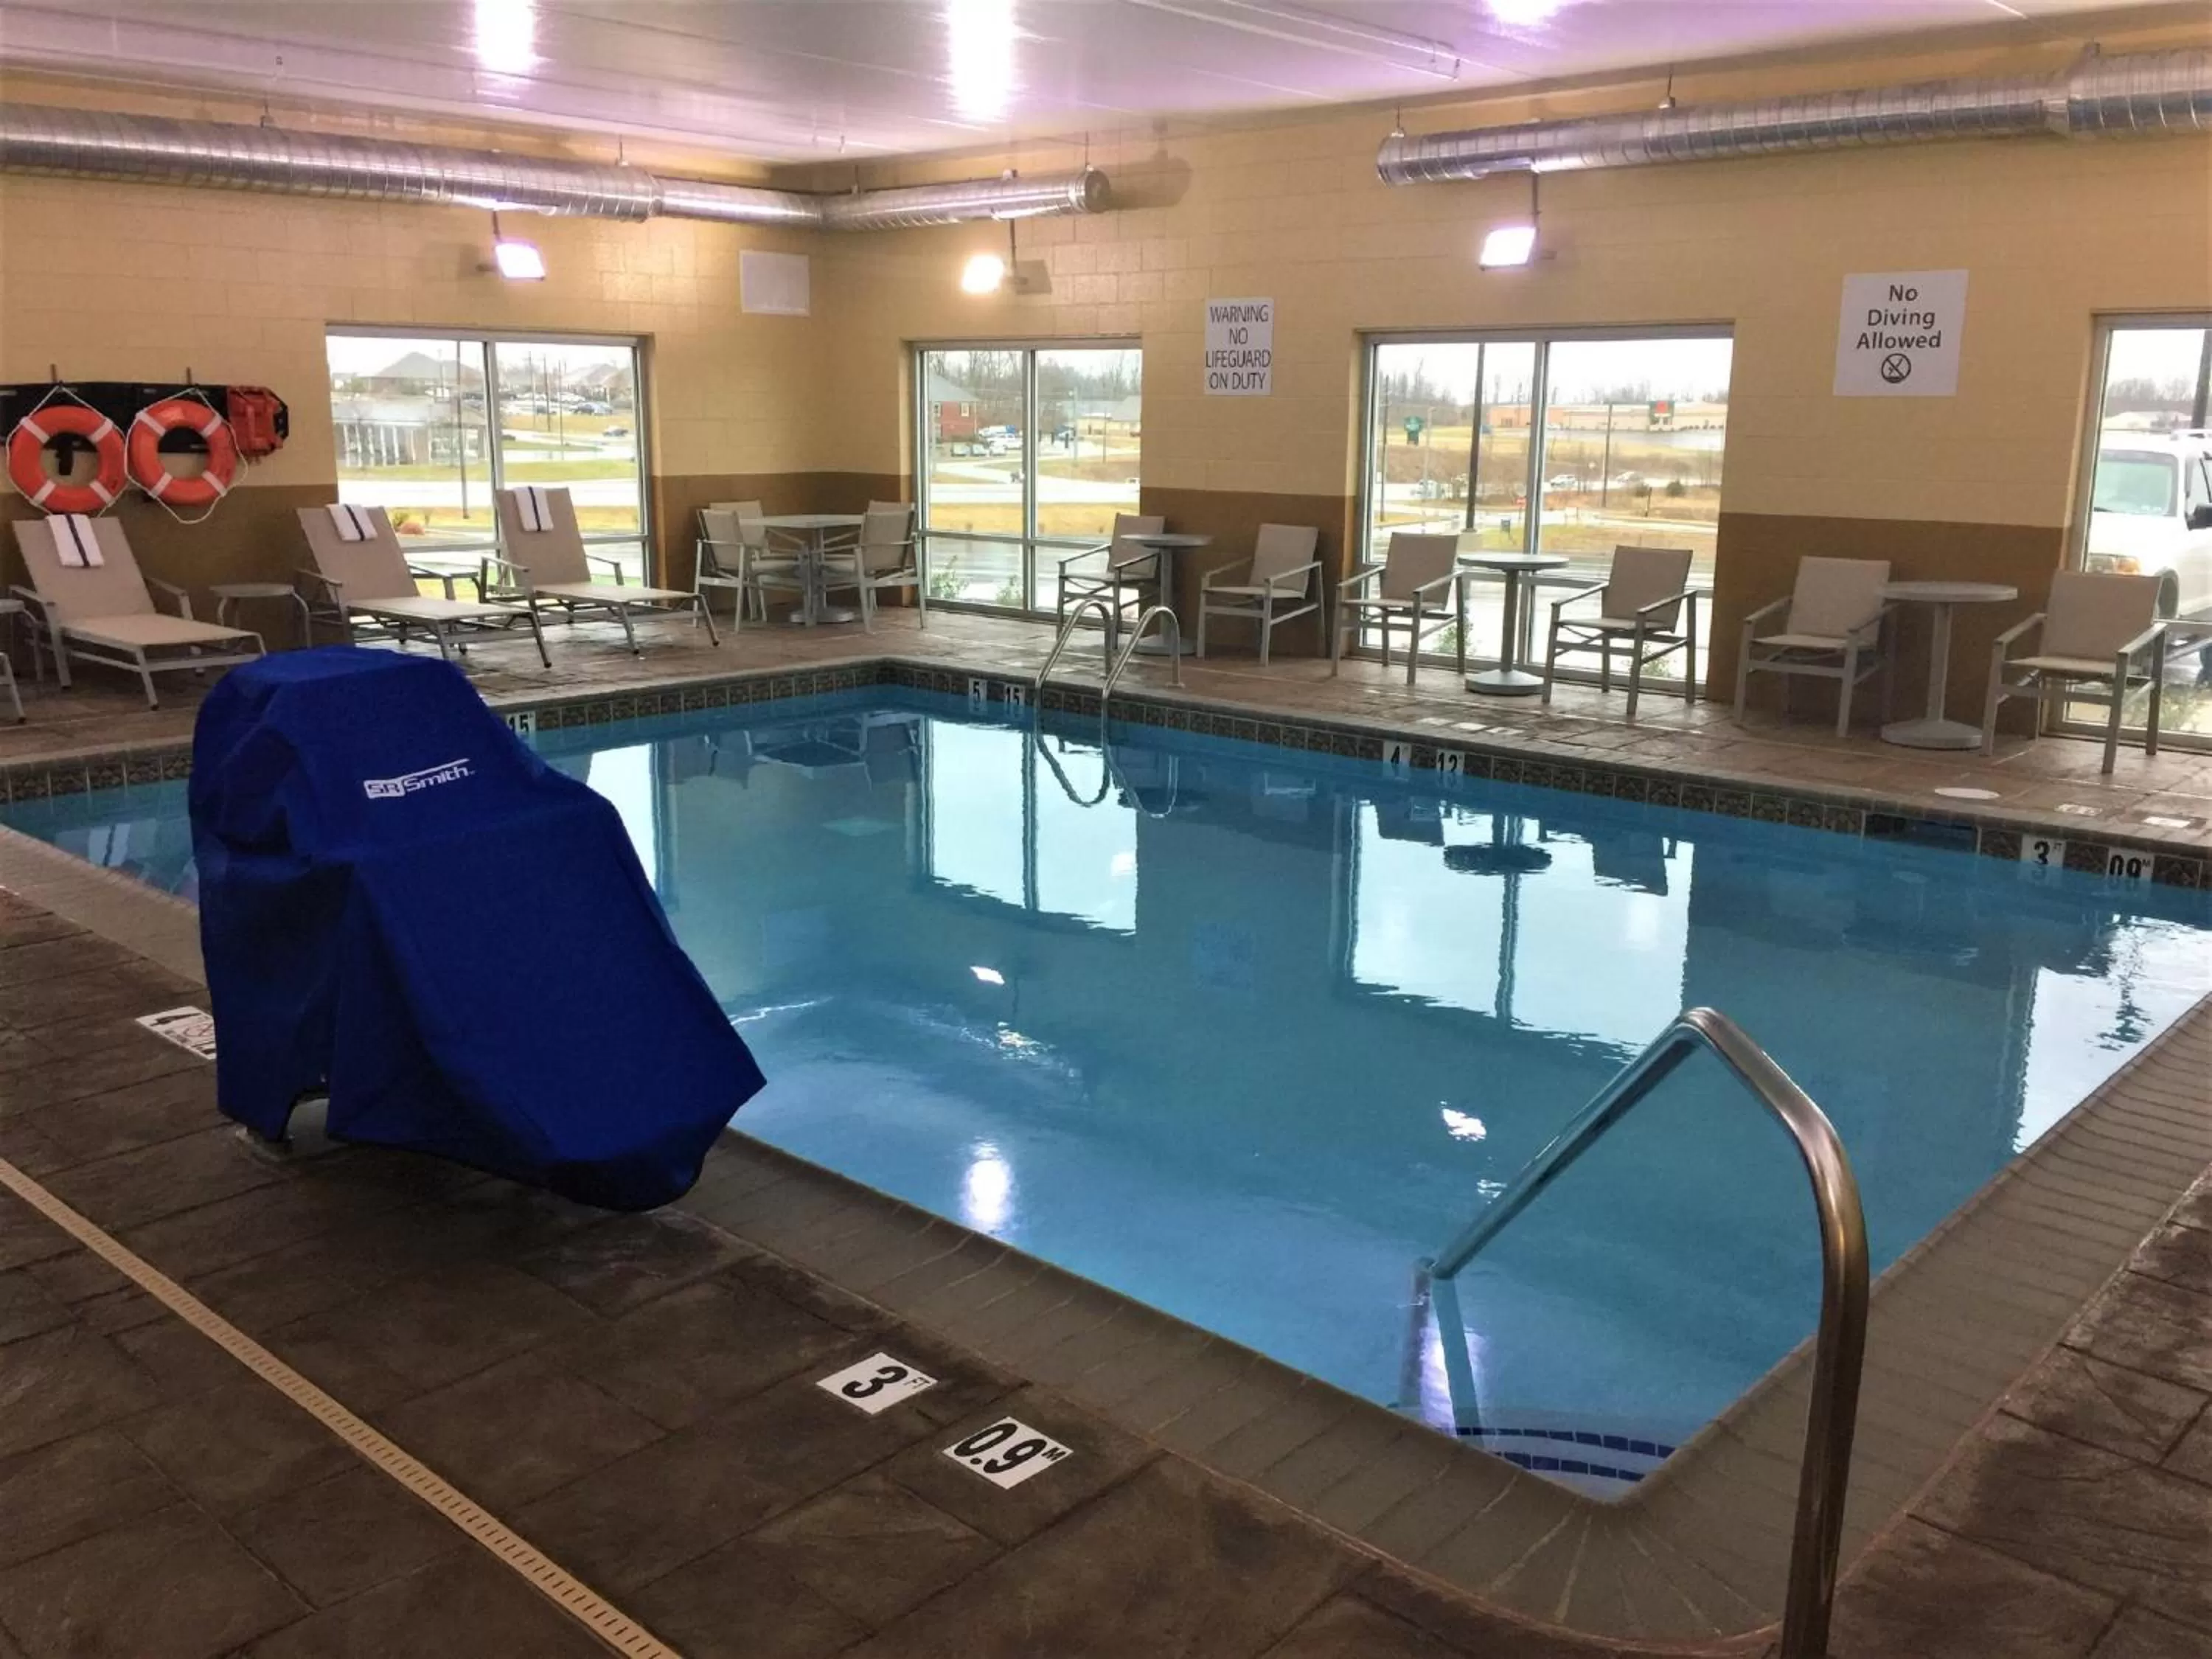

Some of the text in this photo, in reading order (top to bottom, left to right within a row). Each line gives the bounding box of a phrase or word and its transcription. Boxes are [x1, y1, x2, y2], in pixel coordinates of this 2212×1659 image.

[1888, 284, 1919, 302] No
[1209, 305, 1269, 323] WARNING
[1867, 307, 1935, 330] Diving
[1229, 327, 1248, 344] NO
[1856, 330, 1942, 350] Allowed
[1206, 349, 1272, 368] LIFEGUARD
[1208, 372, 1267, 390] ON DUTY
[841, 1366, 908, 1398] 3
